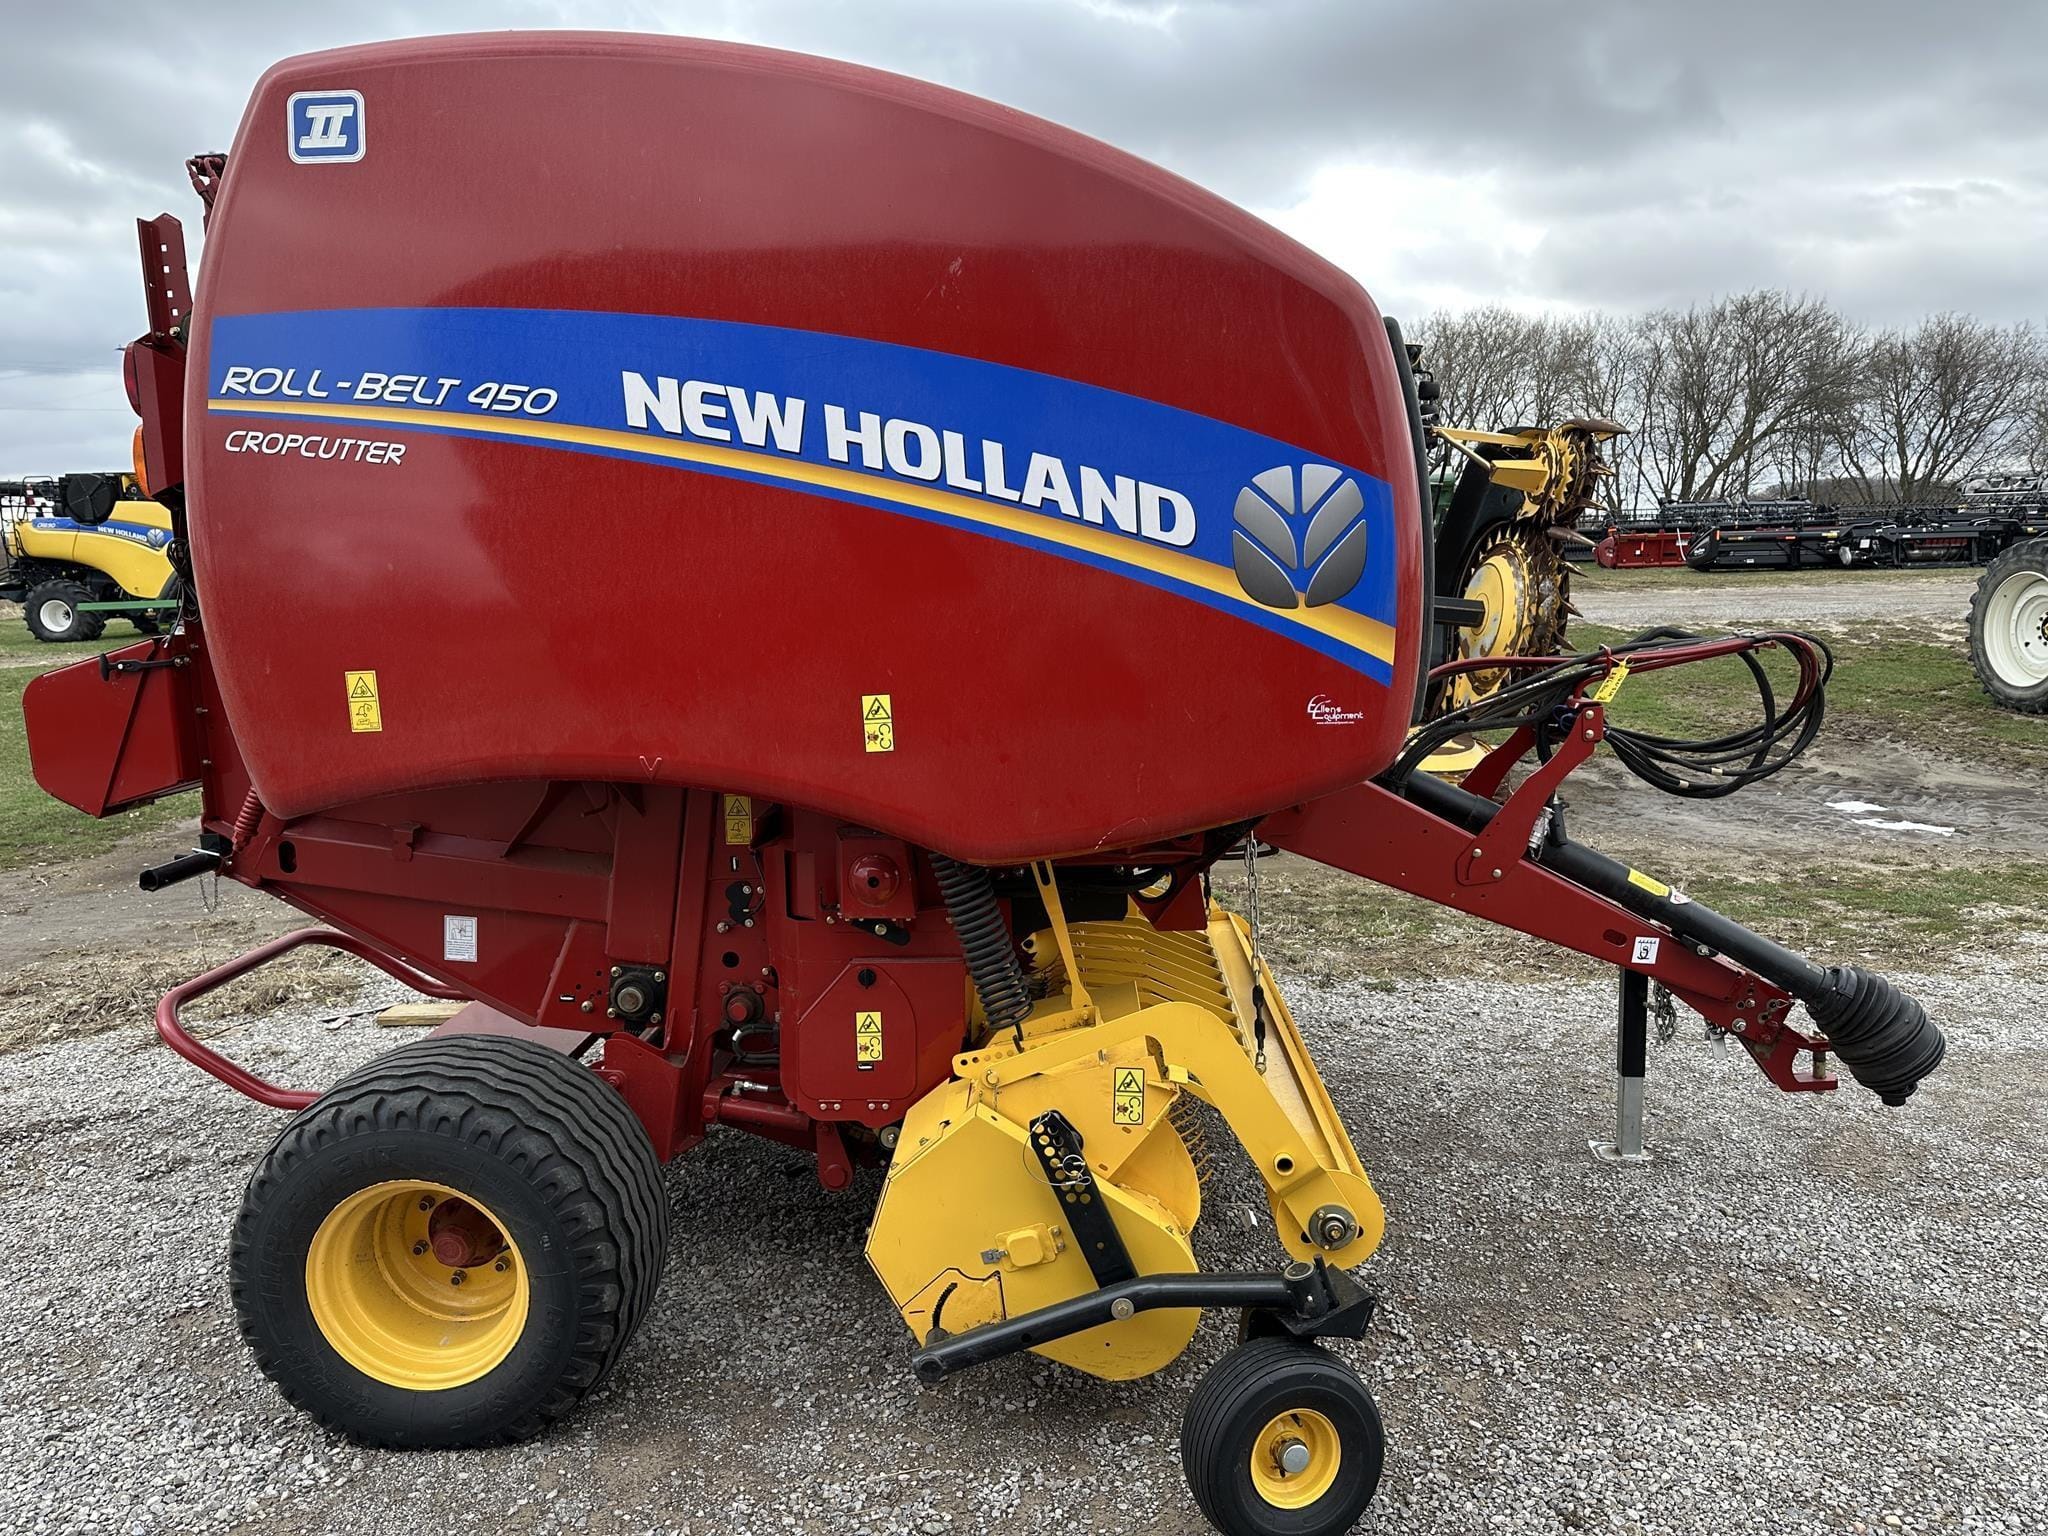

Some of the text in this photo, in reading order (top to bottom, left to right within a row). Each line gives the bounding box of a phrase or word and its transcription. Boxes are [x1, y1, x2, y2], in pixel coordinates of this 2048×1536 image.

[467, 382, 559, 415] 450
[225, 430, 407, 466] CROPCUTTER
[622, 371, 1197, 547] NEW HOLLAND
[98, 526, 147, 542] NEW HOLLAND
